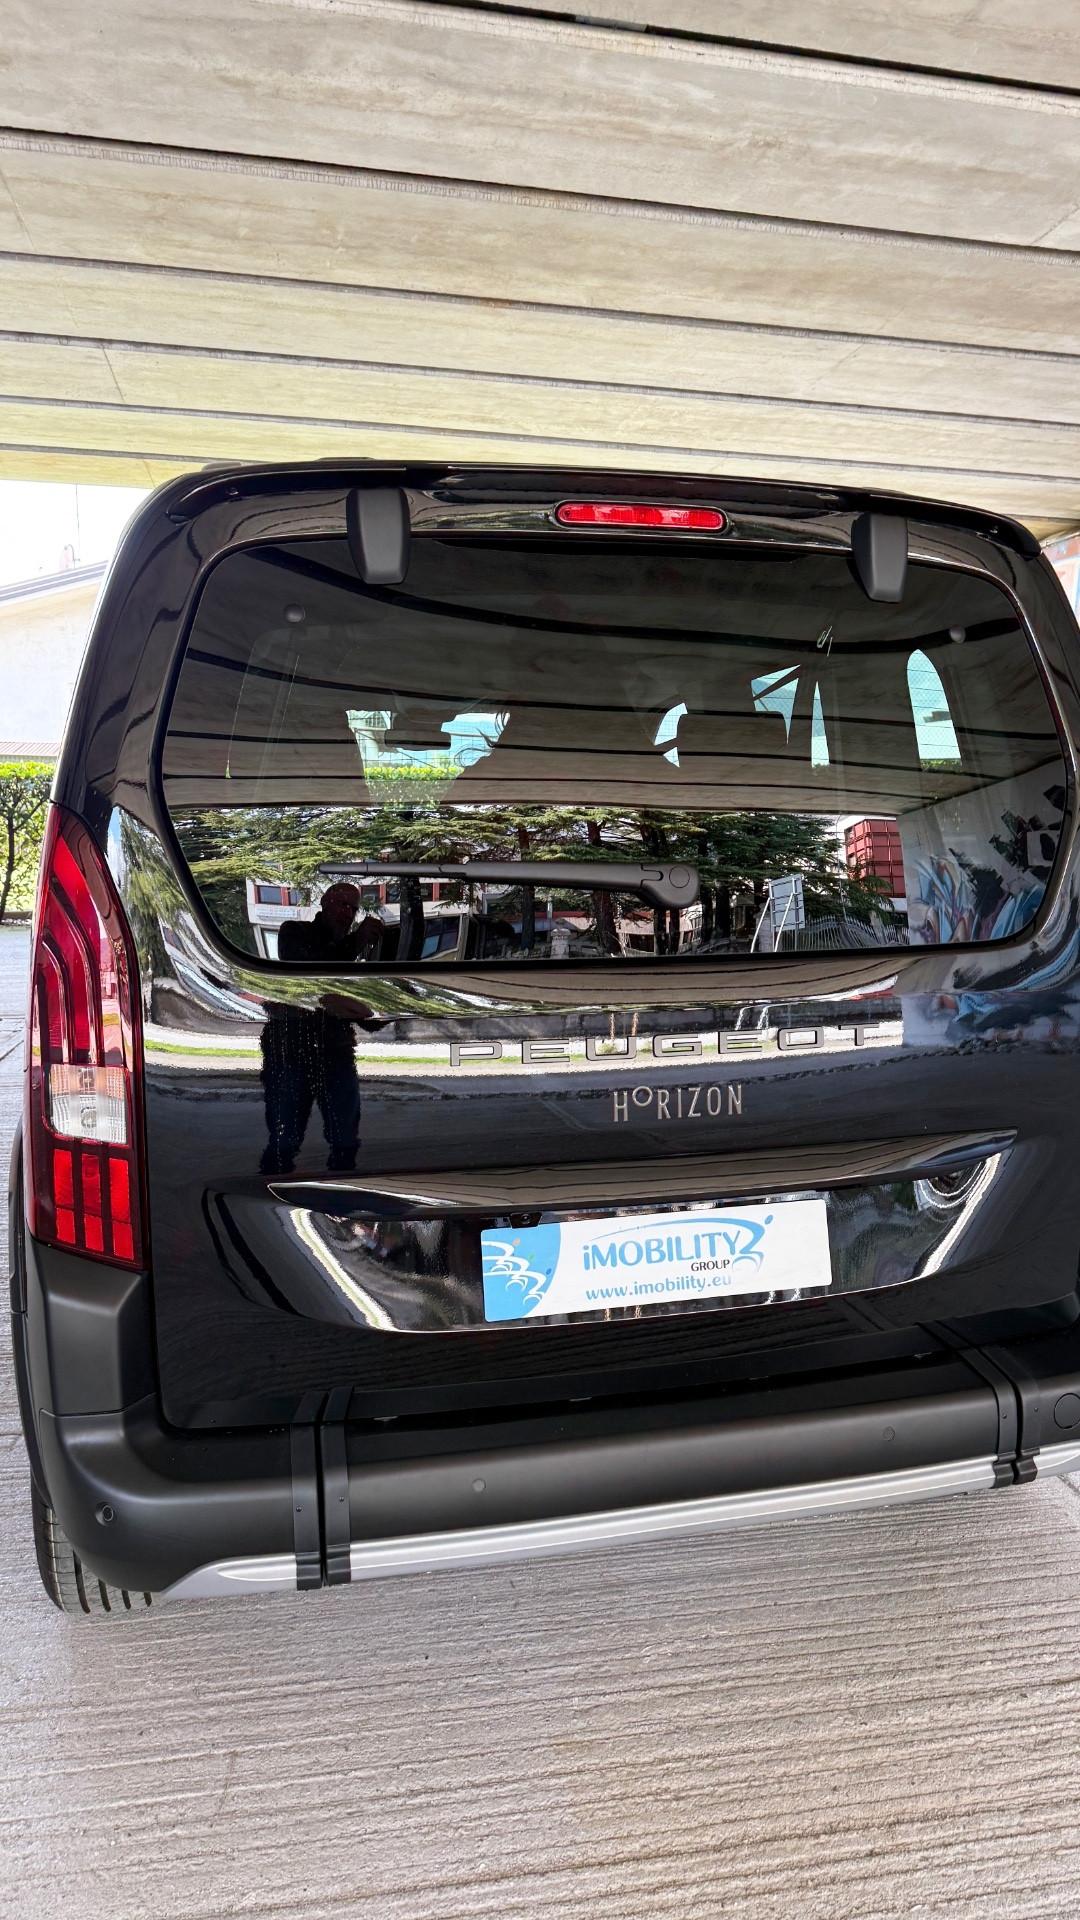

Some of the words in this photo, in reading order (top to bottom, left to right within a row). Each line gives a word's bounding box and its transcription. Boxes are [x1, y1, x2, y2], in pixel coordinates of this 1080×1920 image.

[449, 1023, 880, 1067] PEUGEOT
[582, 1230, 741, 1271] iMOBILITY
[690, 1258, 731, 1272] GROUP
[585, 1275, 732, 1301] www.imobility.eu
